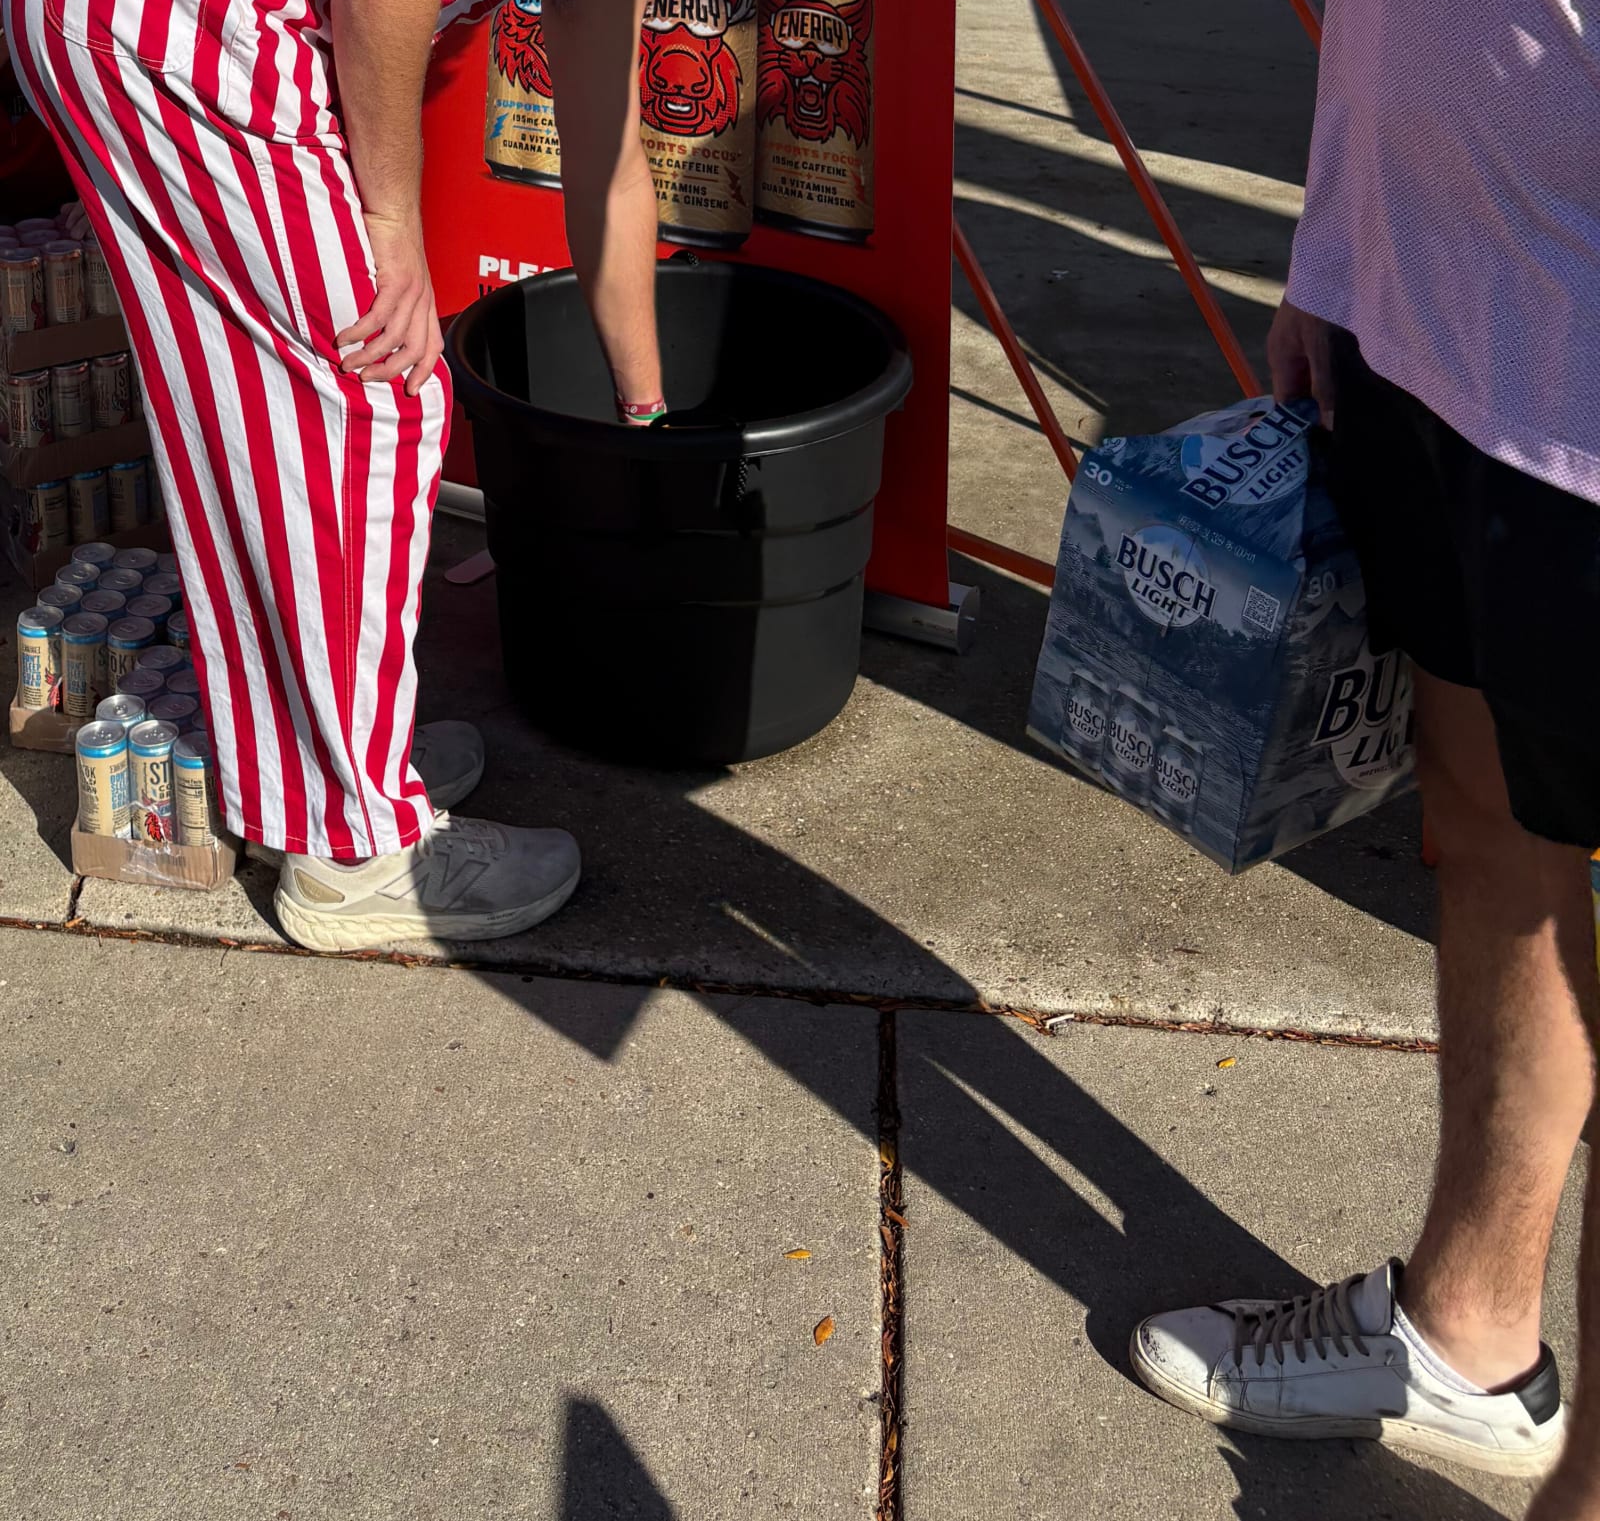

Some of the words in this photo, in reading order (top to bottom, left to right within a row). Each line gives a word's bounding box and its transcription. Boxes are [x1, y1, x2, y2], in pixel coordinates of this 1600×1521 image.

[778, 11, 844, 48] ENERGY
[503, 140, 542, 153] GUARANA
[529, 134, 559, 146] VITAM
[641, 138, 687, 155] ORTS
[666, 158, 720, 175] CAFFEINE
[802, 161, 847, 177] CAFFEINE
[652, 178, 707, 196] VITAMINS
[761, 182, 803, 199] GUARANA
[817, 194, 855, 208] GINSENG
[790, 179, 838, 195] VITAMINS
[683, 195, 729, 210] GINSENG
[479, 254, 555, 282] PLE
[1183, 403, 1310, 508] BUSCH
[1084, 461, 1113, 486] 30
[1249, 449, 1304, 500] LIGHT
[1116, 535, 1216, 618] BUSCH
[1131, 578, 1190, 618] LIGHT
[1066, 699, 1106, 734] BUSCH
[1072, 718, 1100, 738] LIGHT
[1109, 720, 1154, 763] BUSCH
[1115, 742, 1145, 768] LIGHT
[1157, 758, 1198, 795] BUSCH
[1161, 777, 1190, 799] LIGHT
